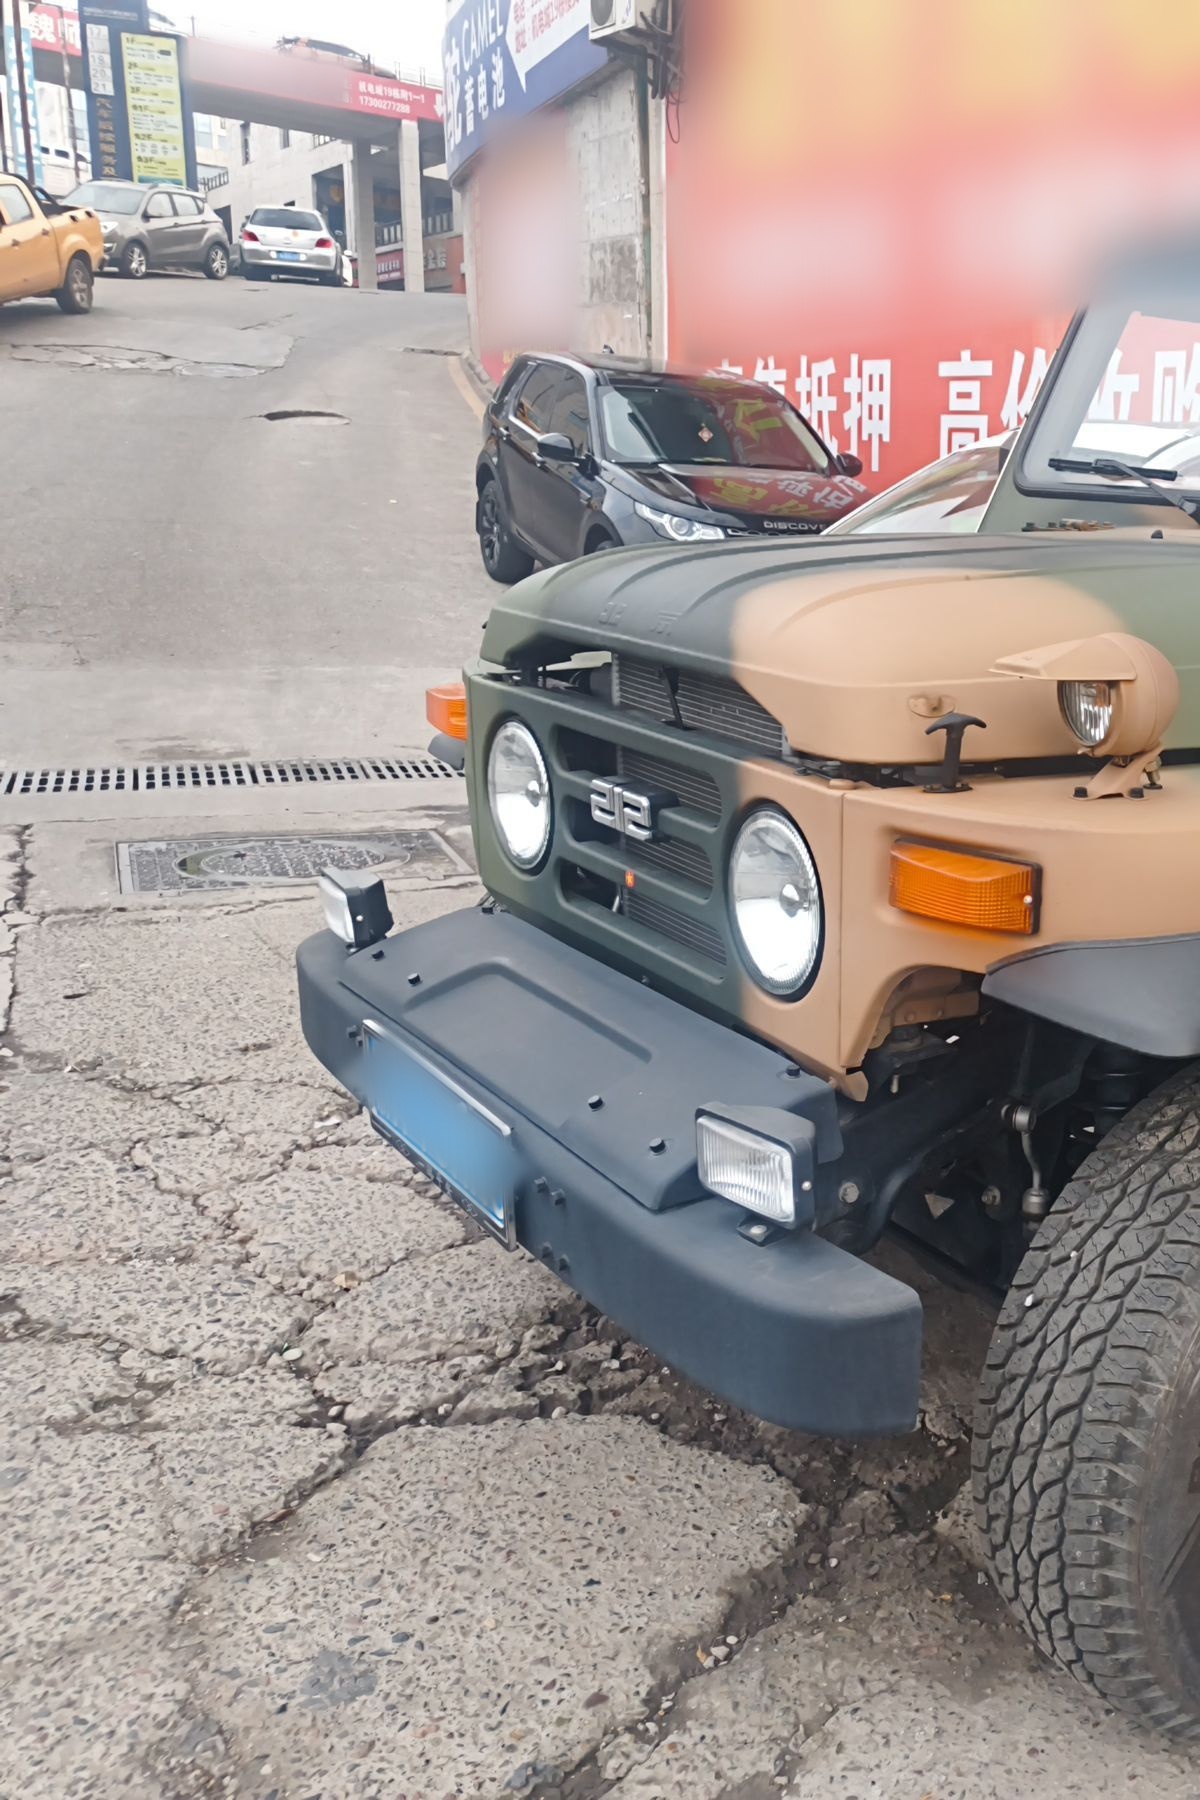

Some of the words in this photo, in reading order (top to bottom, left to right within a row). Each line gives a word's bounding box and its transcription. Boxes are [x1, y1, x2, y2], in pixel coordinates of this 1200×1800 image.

[462, 0, 504, 72] CAMEL
[464, 46, 505, 137] 蓄电池
[763, 520, 827, 531] DISCOVE
